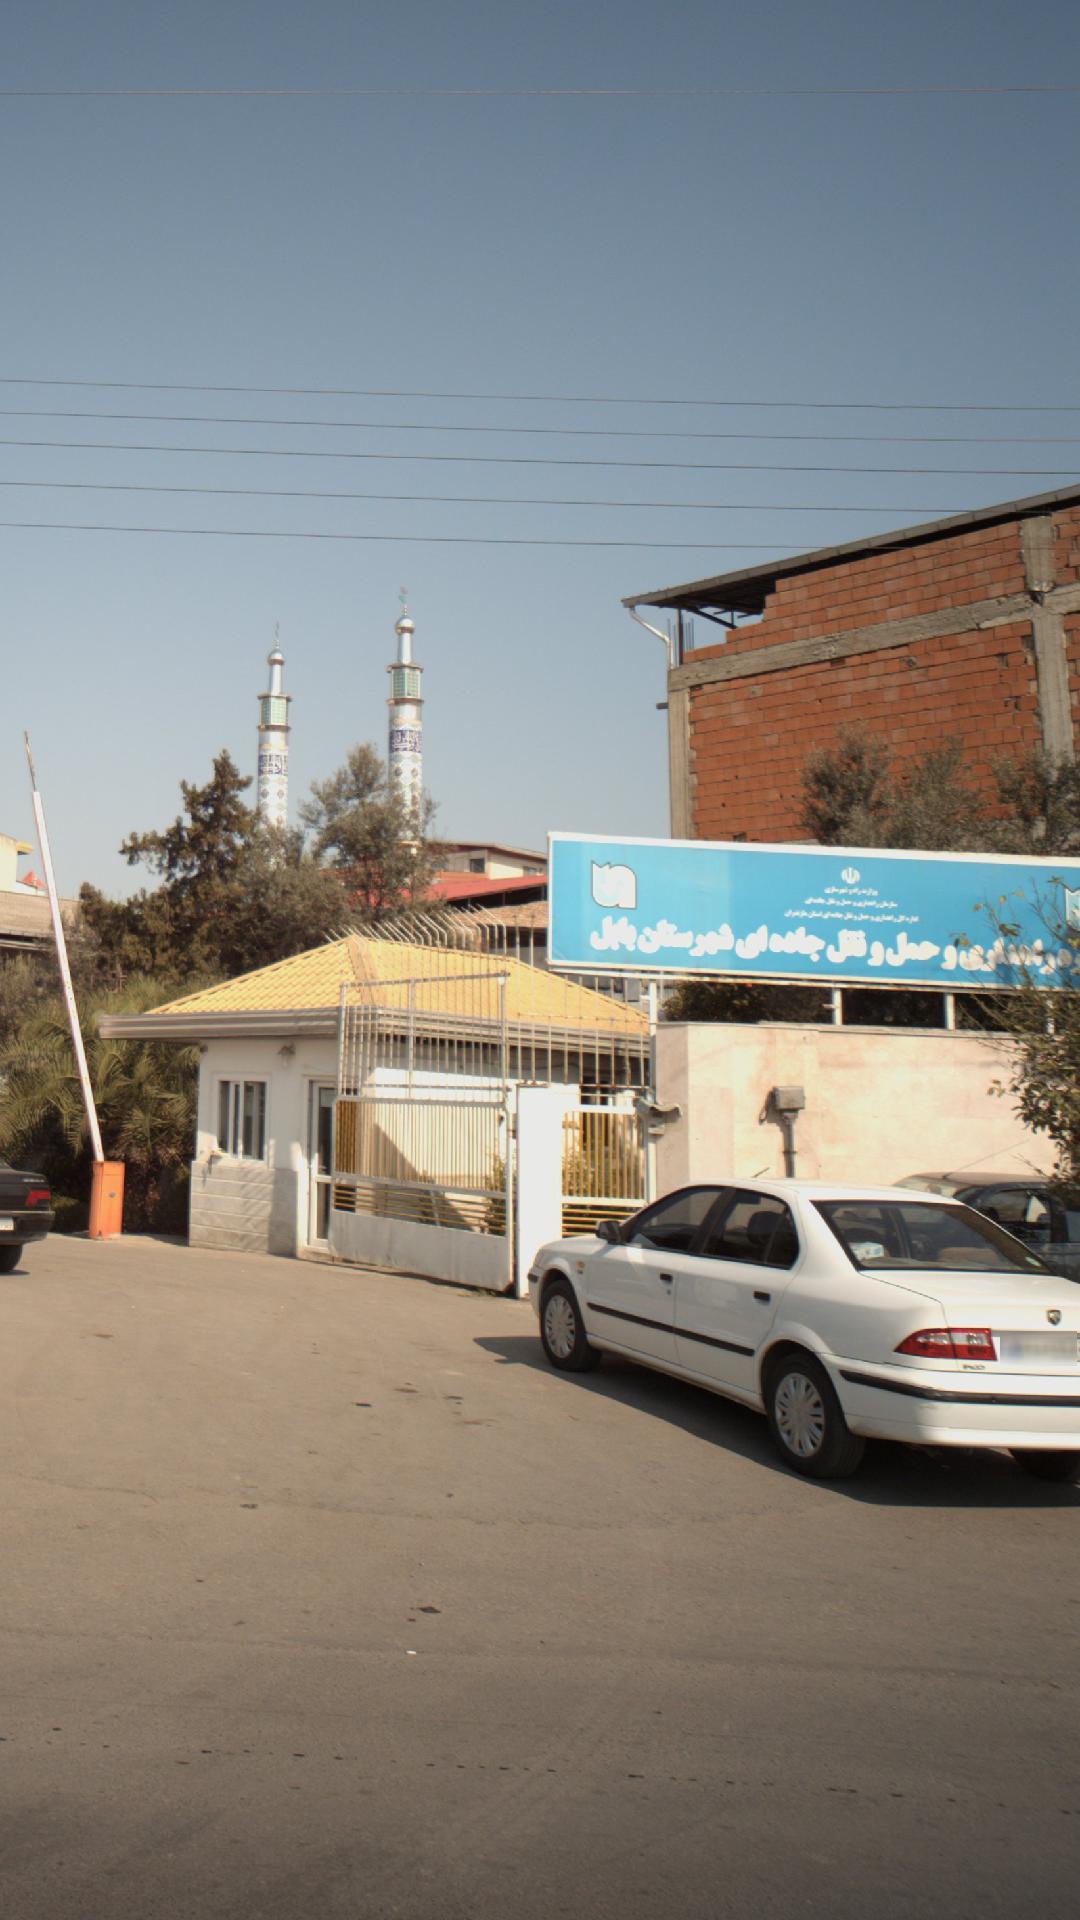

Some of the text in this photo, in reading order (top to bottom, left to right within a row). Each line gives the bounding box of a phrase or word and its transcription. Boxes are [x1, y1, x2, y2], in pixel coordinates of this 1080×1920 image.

[590, 915, 637, 951] بابل
[638, 919, 734, 957] شهرستان
[827, 929, 867, 963] نقل
[886, 932, 940, 966] حمل
[868, 941, 885, 966] و
[942, 945, 957, 969] و
